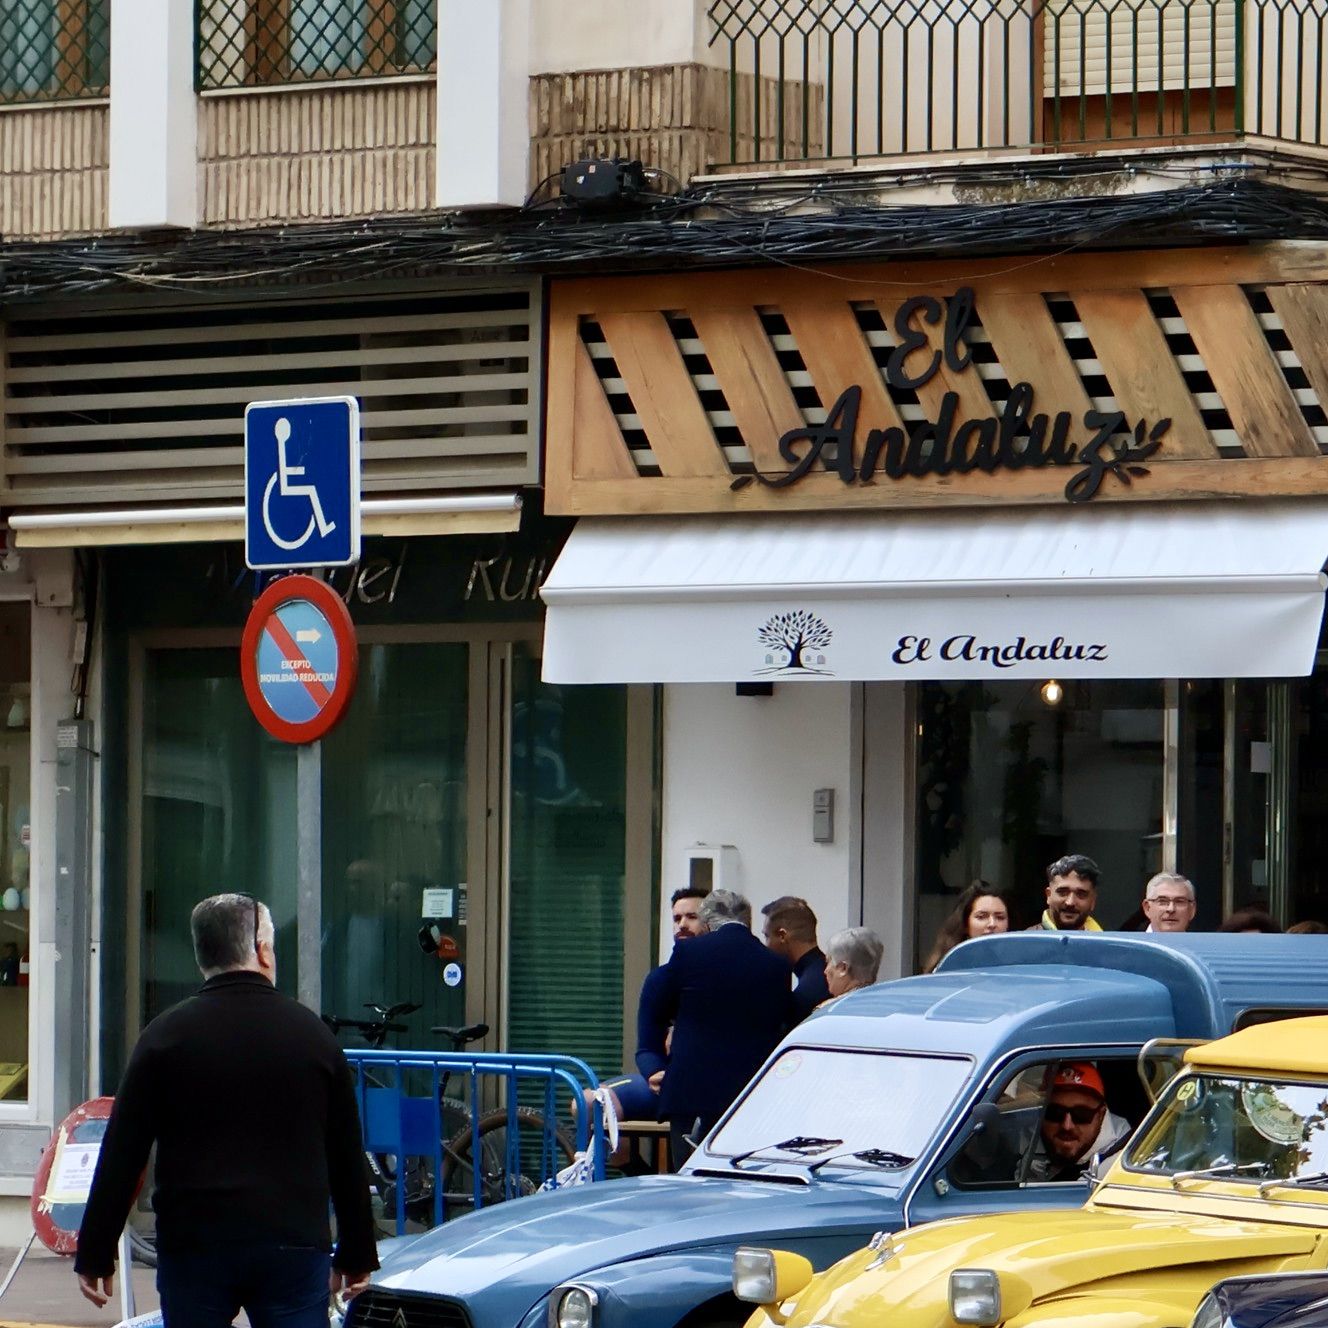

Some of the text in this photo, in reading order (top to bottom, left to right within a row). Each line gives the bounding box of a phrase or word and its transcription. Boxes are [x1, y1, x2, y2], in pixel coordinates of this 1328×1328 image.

[888, 286, 975, 389] El
[754, 382, 1127, 503] Andaluz
[281, 659, 311, 670] EXCEPTO
[891, 634, 1109, 668] El Andaluz
[260, 672, 334, 683] MOVILIDAD REDUCIDA
